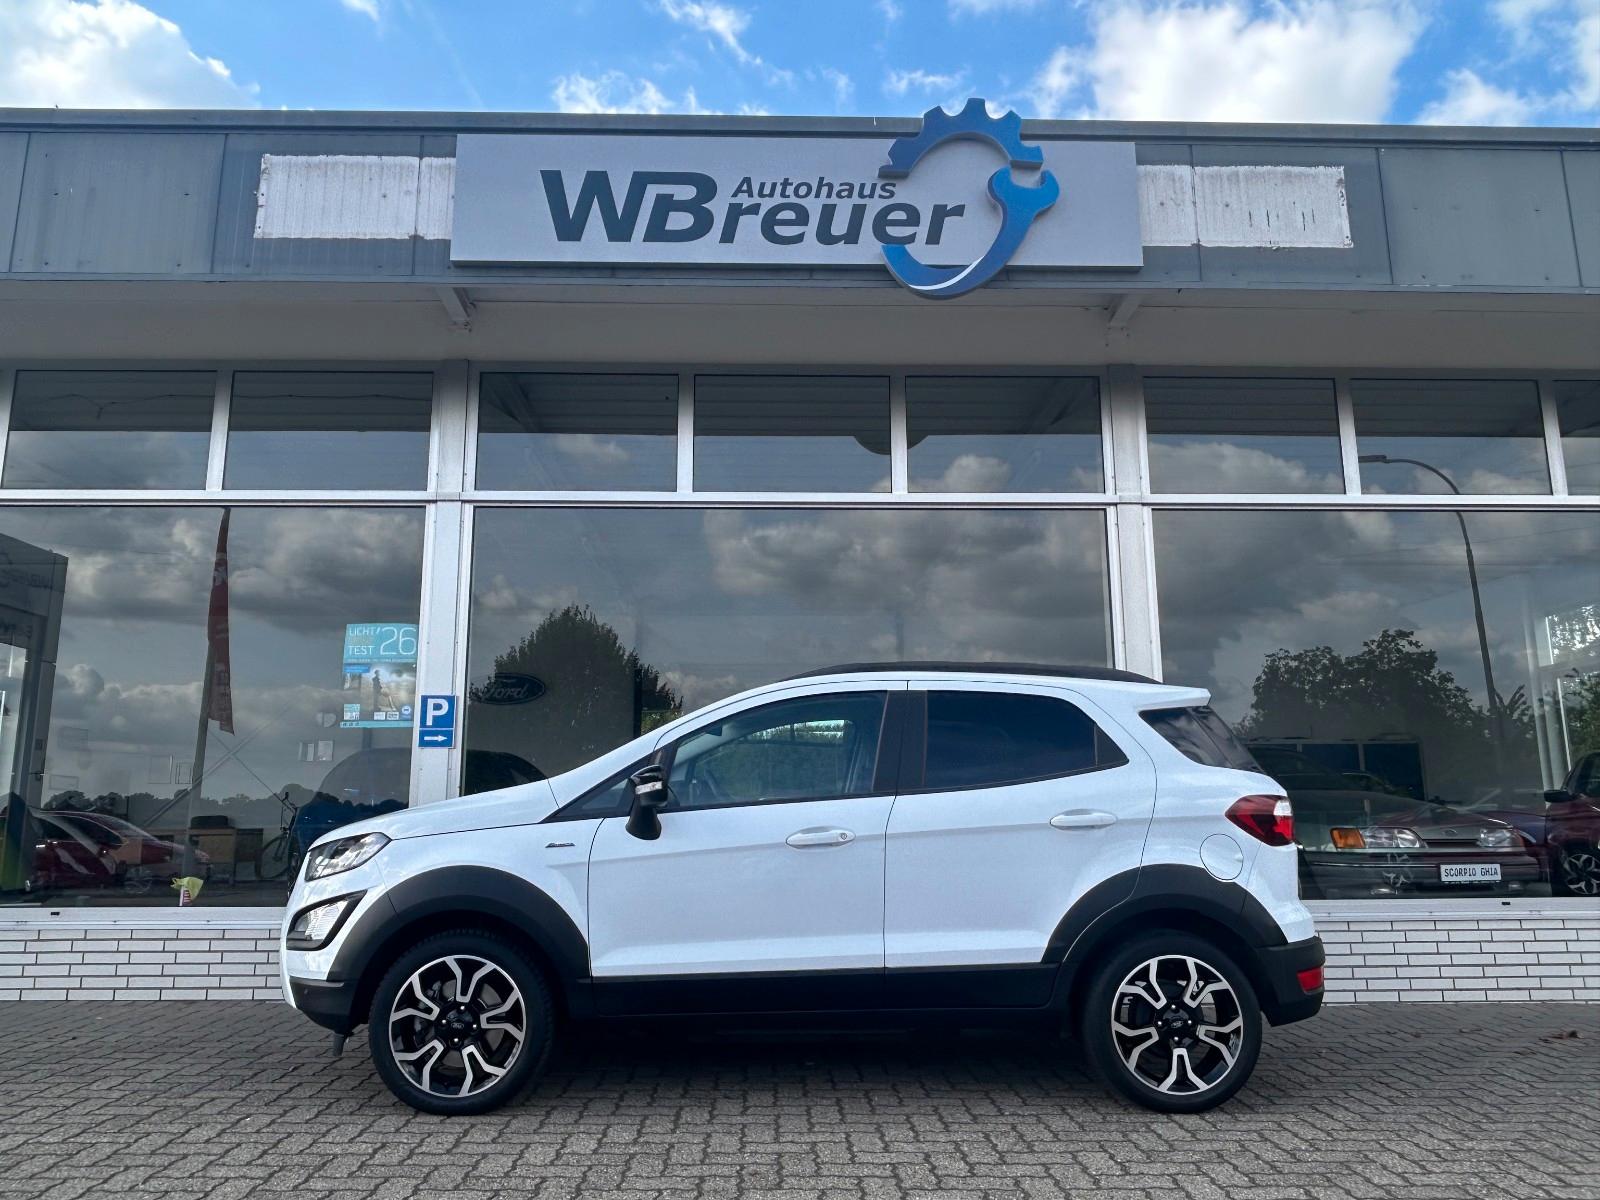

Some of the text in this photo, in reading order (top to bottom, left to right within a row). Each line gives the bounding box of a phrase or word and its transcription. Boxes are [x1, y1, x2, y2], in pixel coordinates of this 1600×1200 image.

[730, 176, 897, 200] Autohaus
[348, 645, 377, 655] TEST
[425, 698, 449, 726] P
[1444, 867, 1498, 877] SCORPIO GHIA
